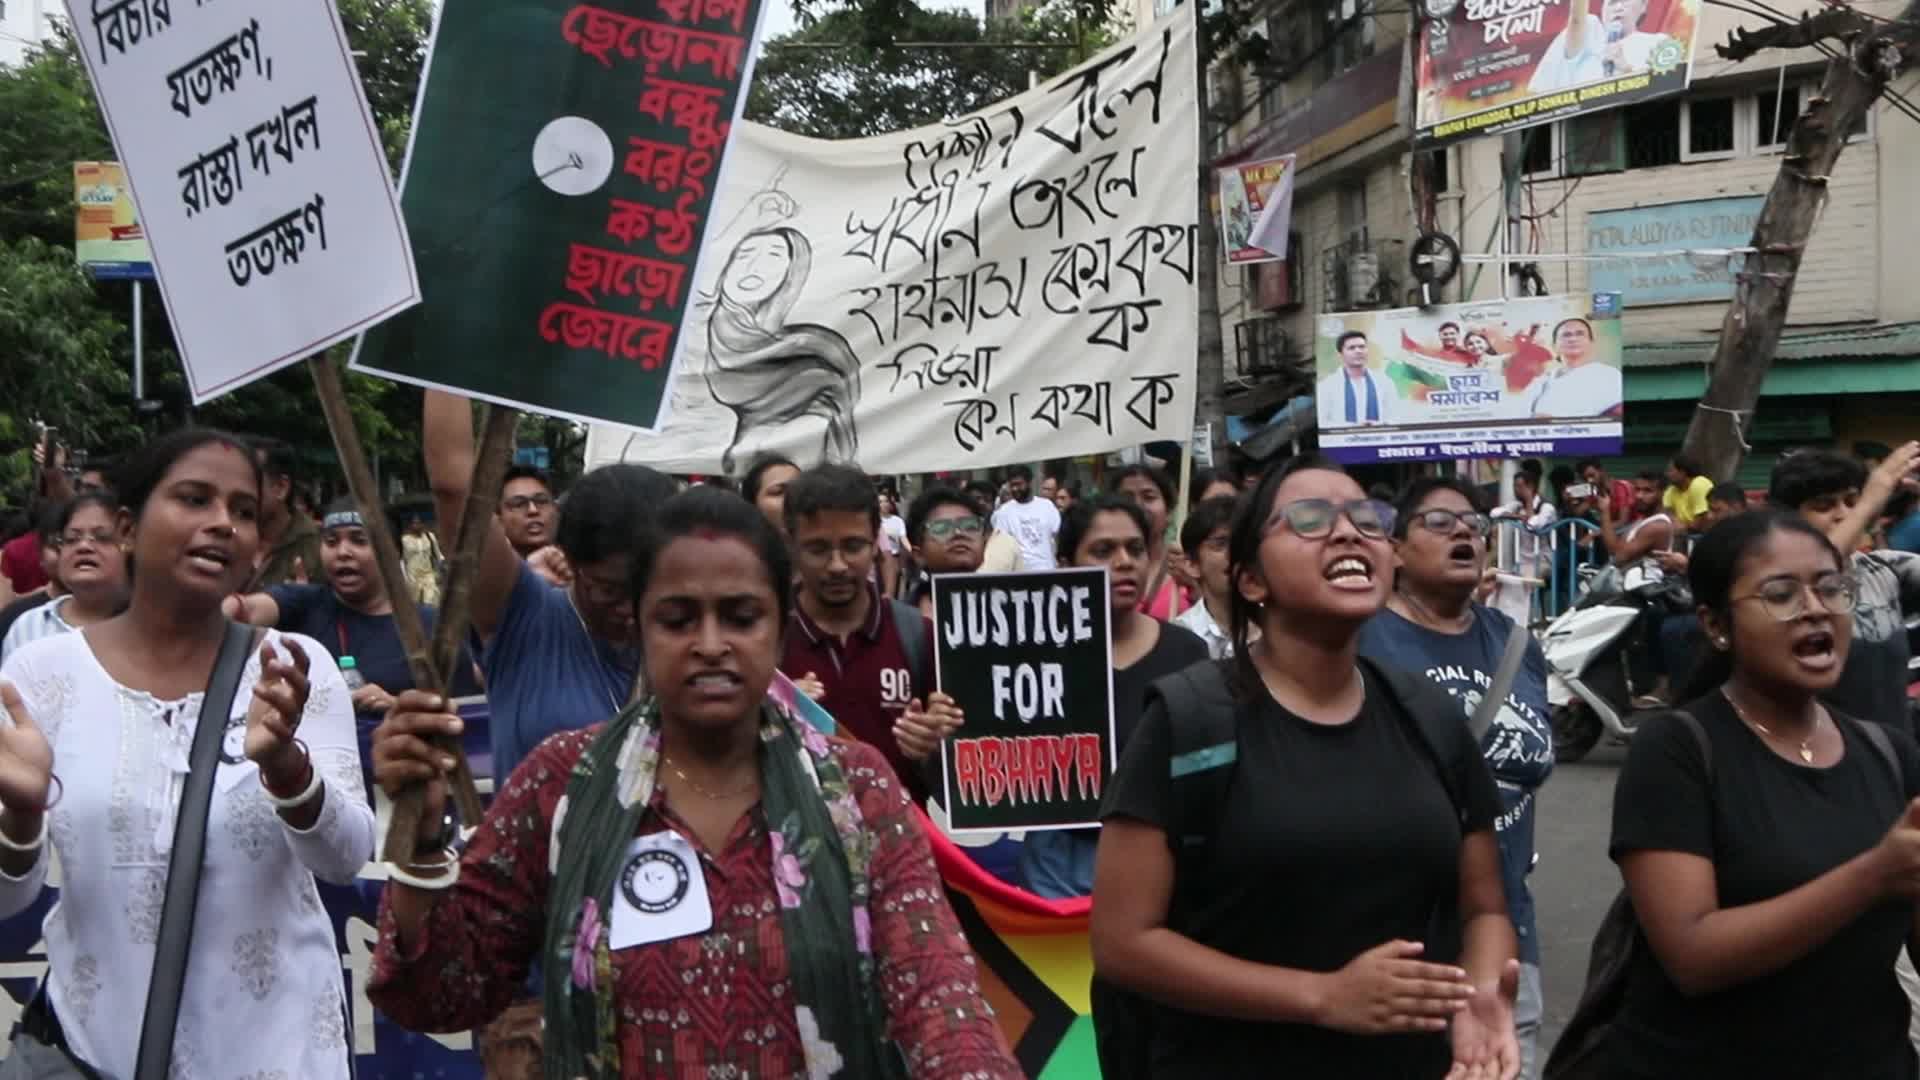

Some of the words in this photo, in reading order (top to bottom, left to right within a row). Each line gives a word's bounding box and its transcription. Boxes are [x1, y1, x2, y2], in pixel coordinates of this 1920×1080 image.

[92, 0, 171, 65] বিচার
[1483, 5, 1545, 43] চলো
[166, 18, 272, 118] যতক্ষণ,
[177, 135, 242, 218] রাস্তা
[245, 95, 320, 175] দখল
[624, 136, 713, 198] বরং
[224, 193, 327, 286] ততক্ষণ
[607, 192, 699, 255] কণ্ঠ
[565, 242, 687, 311] ছাড়ো
[539, 302, 672, 371] জোরে
[1087, 299, 1162, 352] ক
[1032, 381, 1112, 436] কথা
[1126, 373, 1181, 430] ক
[1430, 389, 1500, 405] সমাবেশ
[944, 584, 1093, 650] JUSTICE
[991, 661, 1065, 724] FOR
[954, 732, 1100, 808] ABHAYA
